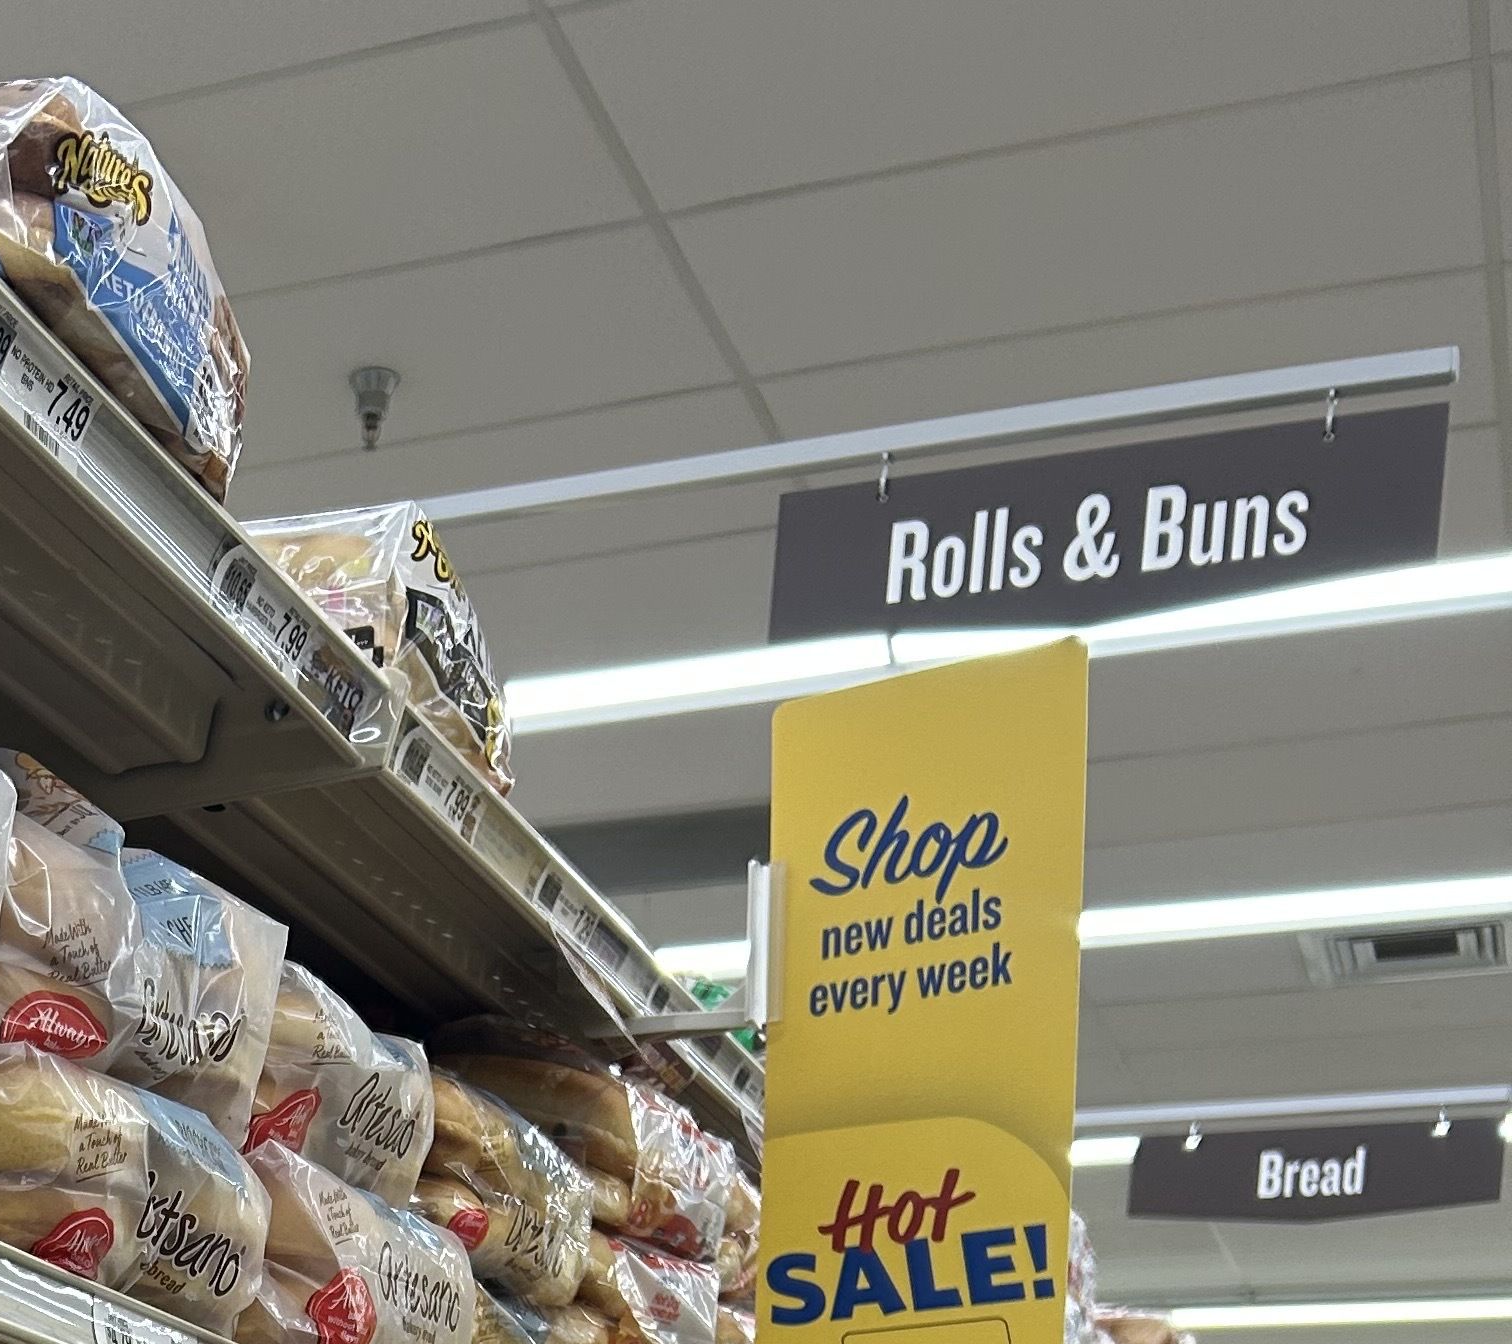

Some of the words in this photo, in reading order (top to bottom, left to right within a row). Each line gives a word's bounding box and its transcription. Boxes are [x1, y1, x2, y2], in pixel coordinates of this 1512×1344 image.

[47, 377, 91, 442] 7.49
[886, 507, 1042, 605] Rolls
[1063, 493, 1120, 581] &
[1141, 484, 1309, 573] Buns
[274, 612, 308, 662] 7.99
[443, 781, 470, 818] 7.99
[809, 796, 1009, 904] Shop
[821, 914, 893, 960] new
[903, 889, 1003, 946] deals
[48, 967, 79, 984] Real
[809, 961, 906, 1017] every
[916, 942, 1013, 997] week
[76, 1157, 101, 1173] Real
[1257, 1147, 1367, 1199] Bread
[819, 1168, 976, 1253] Hot
[765, 1224, 1057, 1325] SALE!
